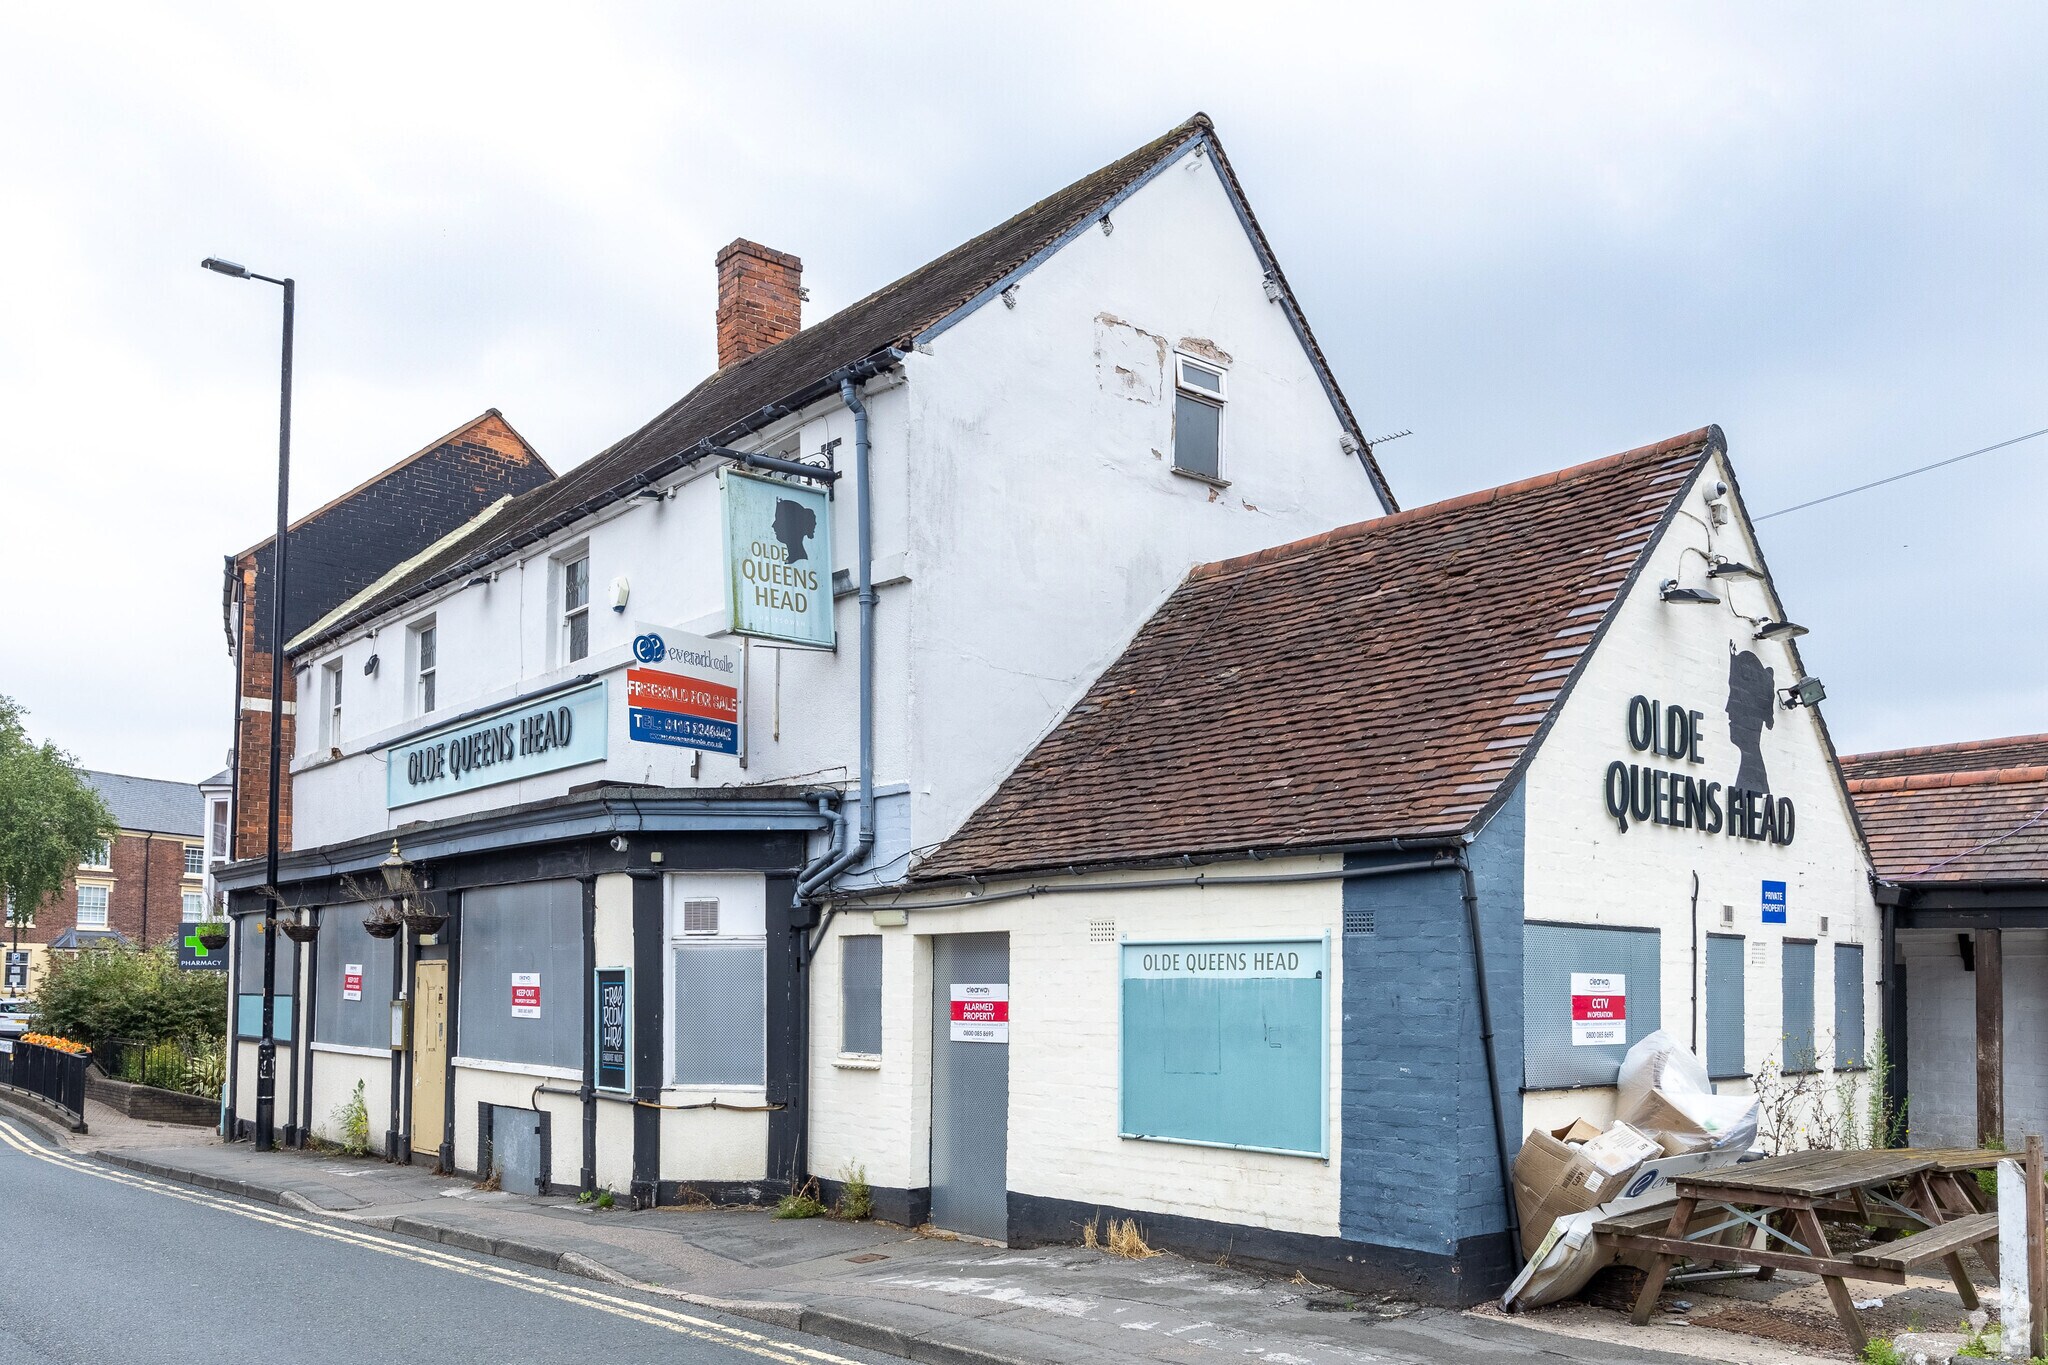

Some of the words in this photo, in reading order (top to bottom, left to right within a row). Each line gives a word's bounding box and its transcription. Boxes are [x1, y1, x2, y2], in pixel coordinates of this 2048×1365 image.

[751, 541, 788, 562] OLDE
[742, 559, 818, 591] QUEENS
[755, 585, 807, 613] HEAD
[628, 680, 689, 703] FREEHOLD
[690, 690, 711, 708] FOR
[713, 695, 737, 712] SALE
[1629, 695, 1704, 764] OLDE
[407, 743, 445, 786] OLDE
[449, 722, 514, 781] QUEENS
[519, 706, 573, 757] HEAD
[1604, 760, 1723, 834] QUEENS
[1727, 786, 1796, 846] HEAD
[1765, 891, 1783, 901] PRIVATE
[1762, 903, 1785, 913] PROPERTY
[1143, 954, 1180, 971] OLDE
[1186, 953, 1247, 974] QUEENS
[1254, 952, 1299, 971] HEAD
[1591, 998, 1609, 1009] CCTV
[603, 1004, 624, 1027] ROOM
[963, 1012, 995, 1020] PROPERTY
